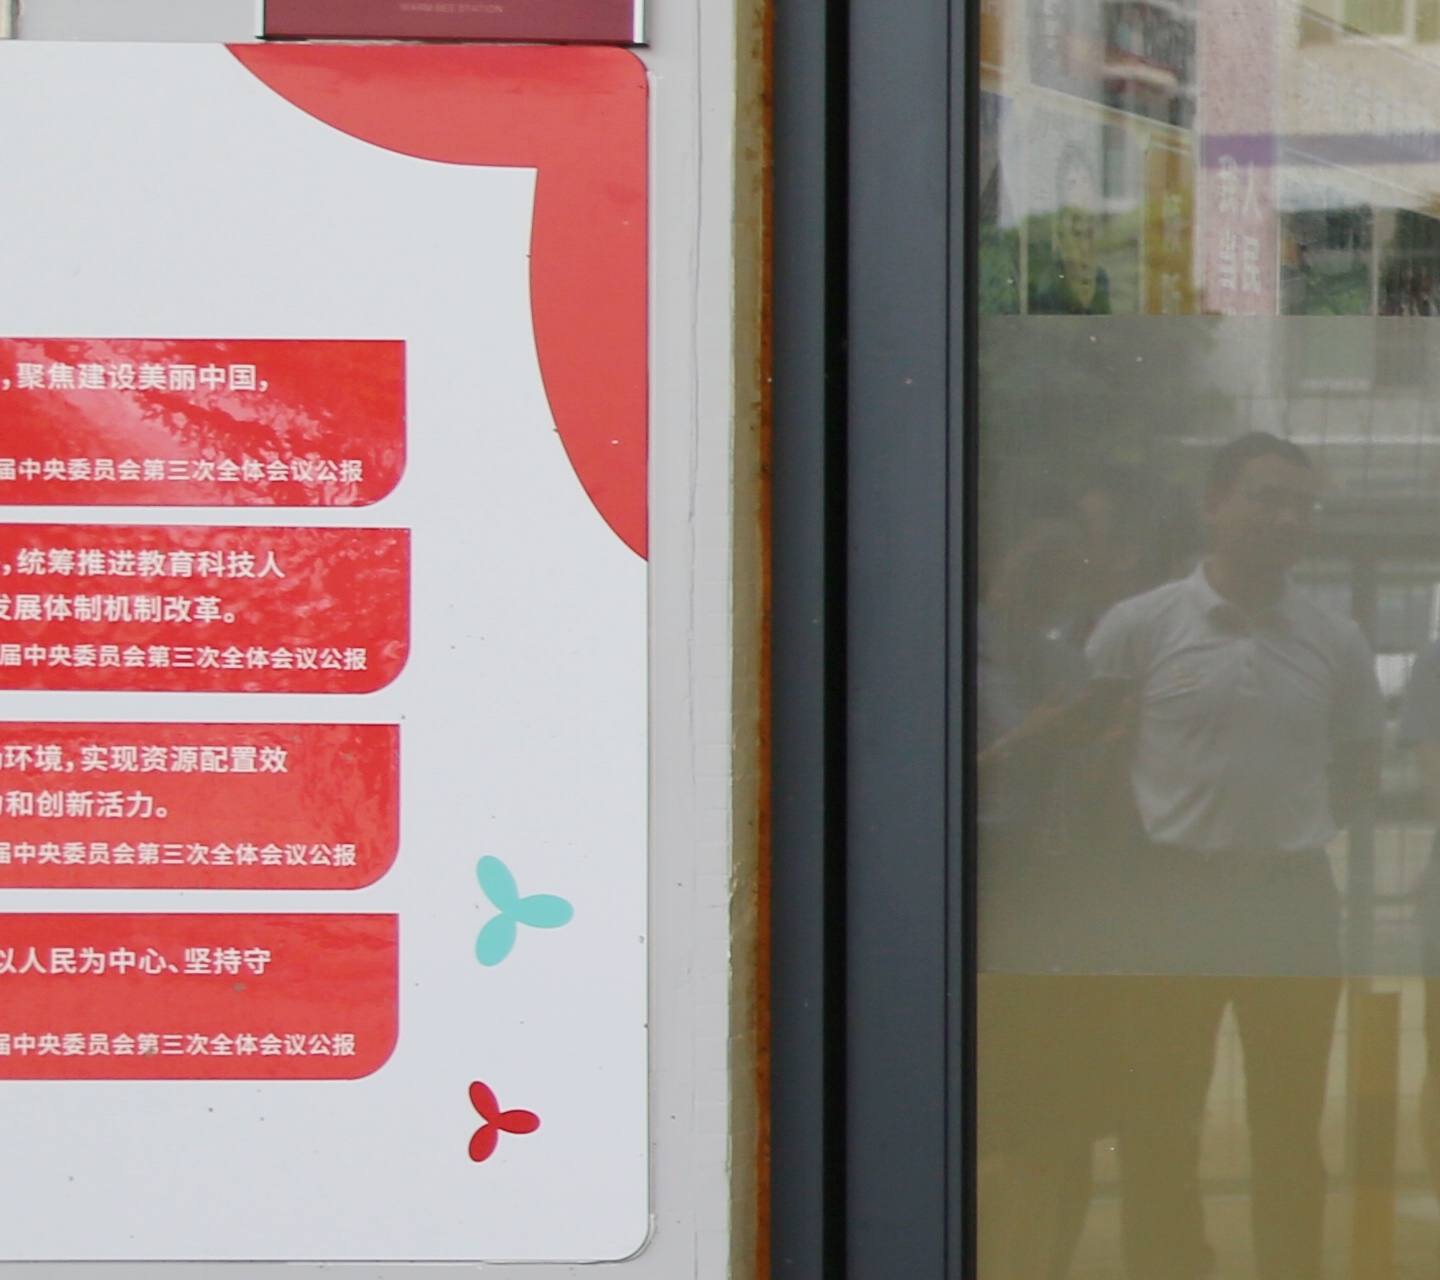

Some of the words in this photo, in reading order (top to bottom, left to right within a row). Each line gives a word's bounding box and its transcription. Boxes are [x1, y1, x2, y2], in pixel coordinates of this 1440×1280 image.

[2, 363, 270, 392] ，聚焦建设美丽中国，
[0, 458, 364, 484] 届中央委员会第三次全体会议公报
[0, 548, 285, 579] ，统筹推进教育科技人
[0, 643, 368, 672] 届中央委员会第三次全体会议公报
[0, 745, 288, 774] 环境，实现资源配置效
[0, 790, 168, 819] 和创新活力。
